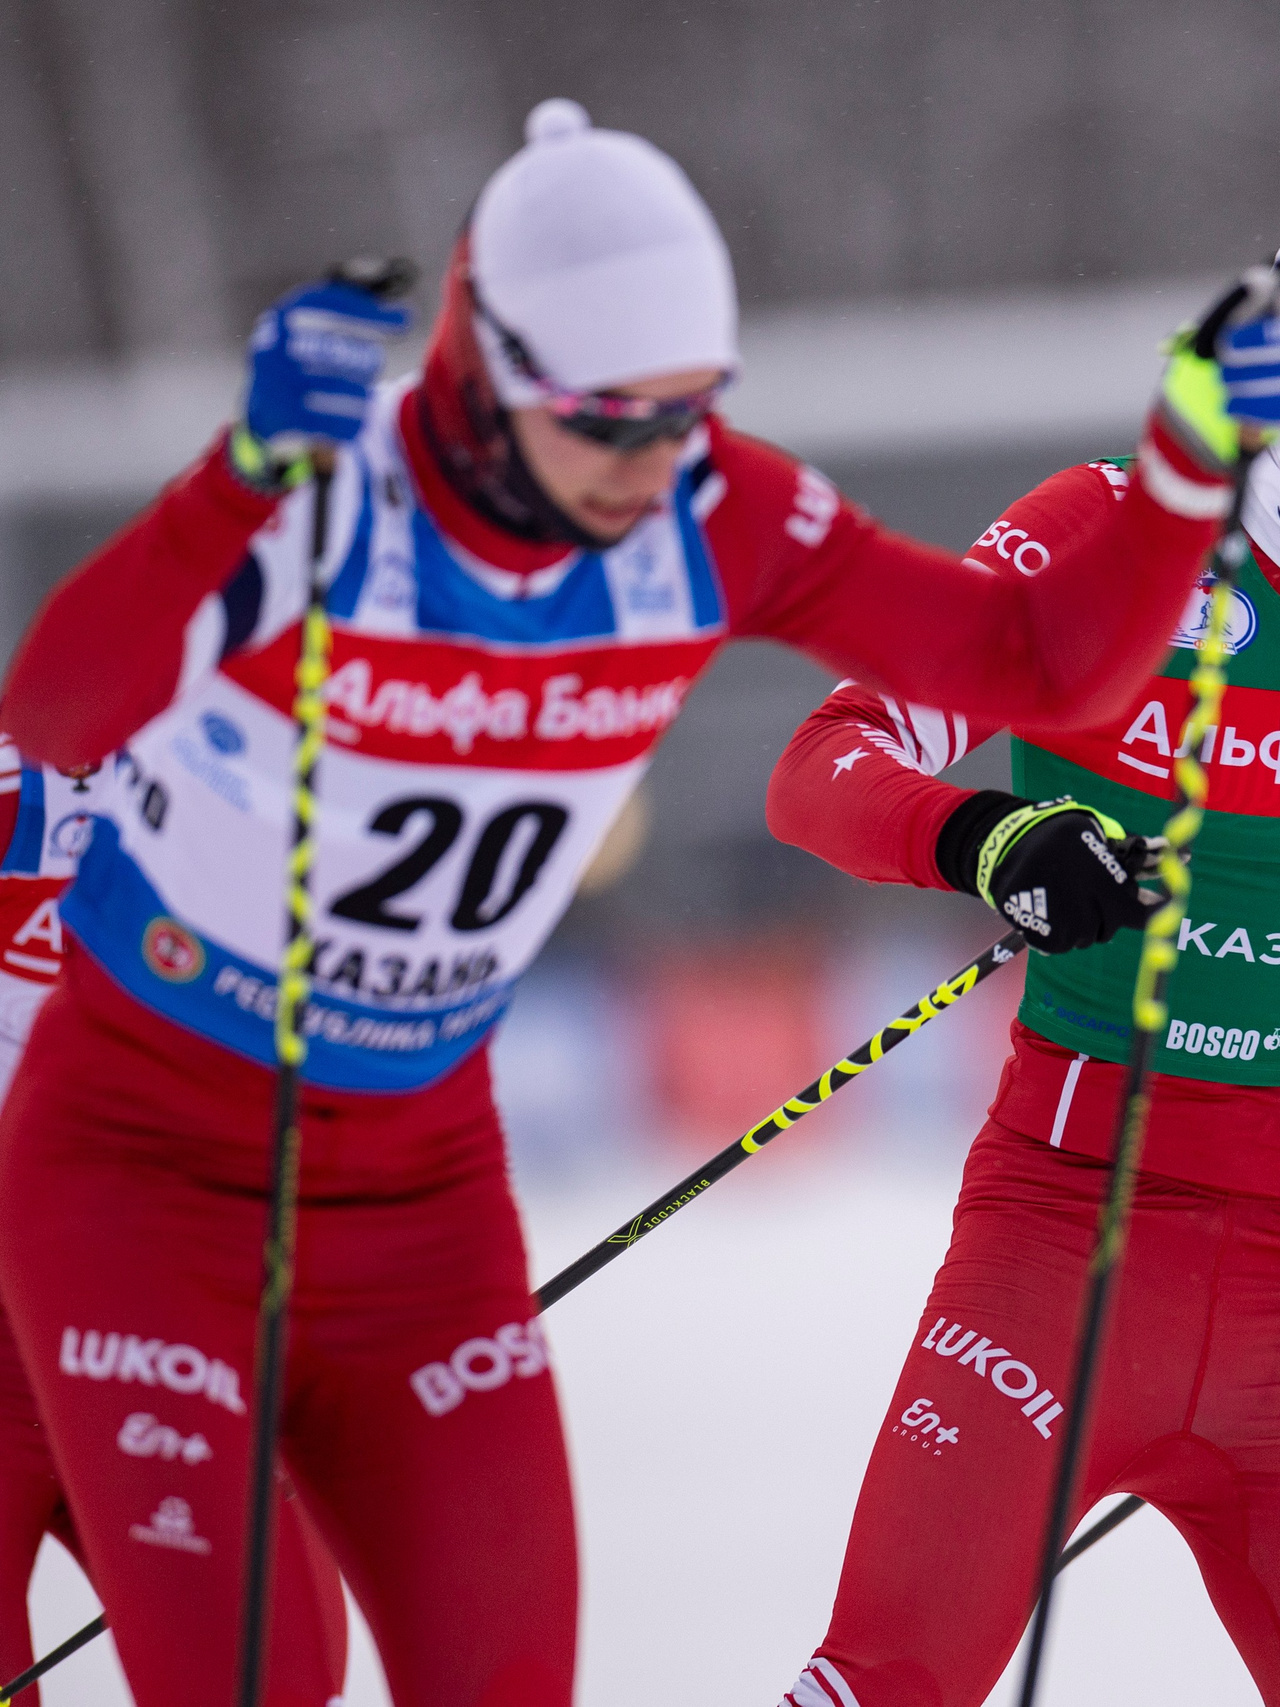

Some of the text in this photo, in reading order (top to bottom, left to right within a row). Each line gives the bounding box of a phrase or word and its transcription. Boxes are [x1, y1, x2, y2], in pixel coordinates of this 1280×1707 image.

[972, 520, 1052, 578] SCO
[320, 657, 530, 755] Альфа
[328, 795, 571, 933] 20
[1080, 830, 1128, 885] adidas
[1003, 900, 1051, 937] adidas
[1165, 1019, 1261, 1061] BOSCO
[643, 1179, 711, 1230] BLACKCODE
[58, 1325, 247, 1415] LUKOIL
[921, 1317, 1068, 1440] LUKOIL
[891, 1425, 942, 1457] GROUP
[901, 1397, 961, 1447] En+
